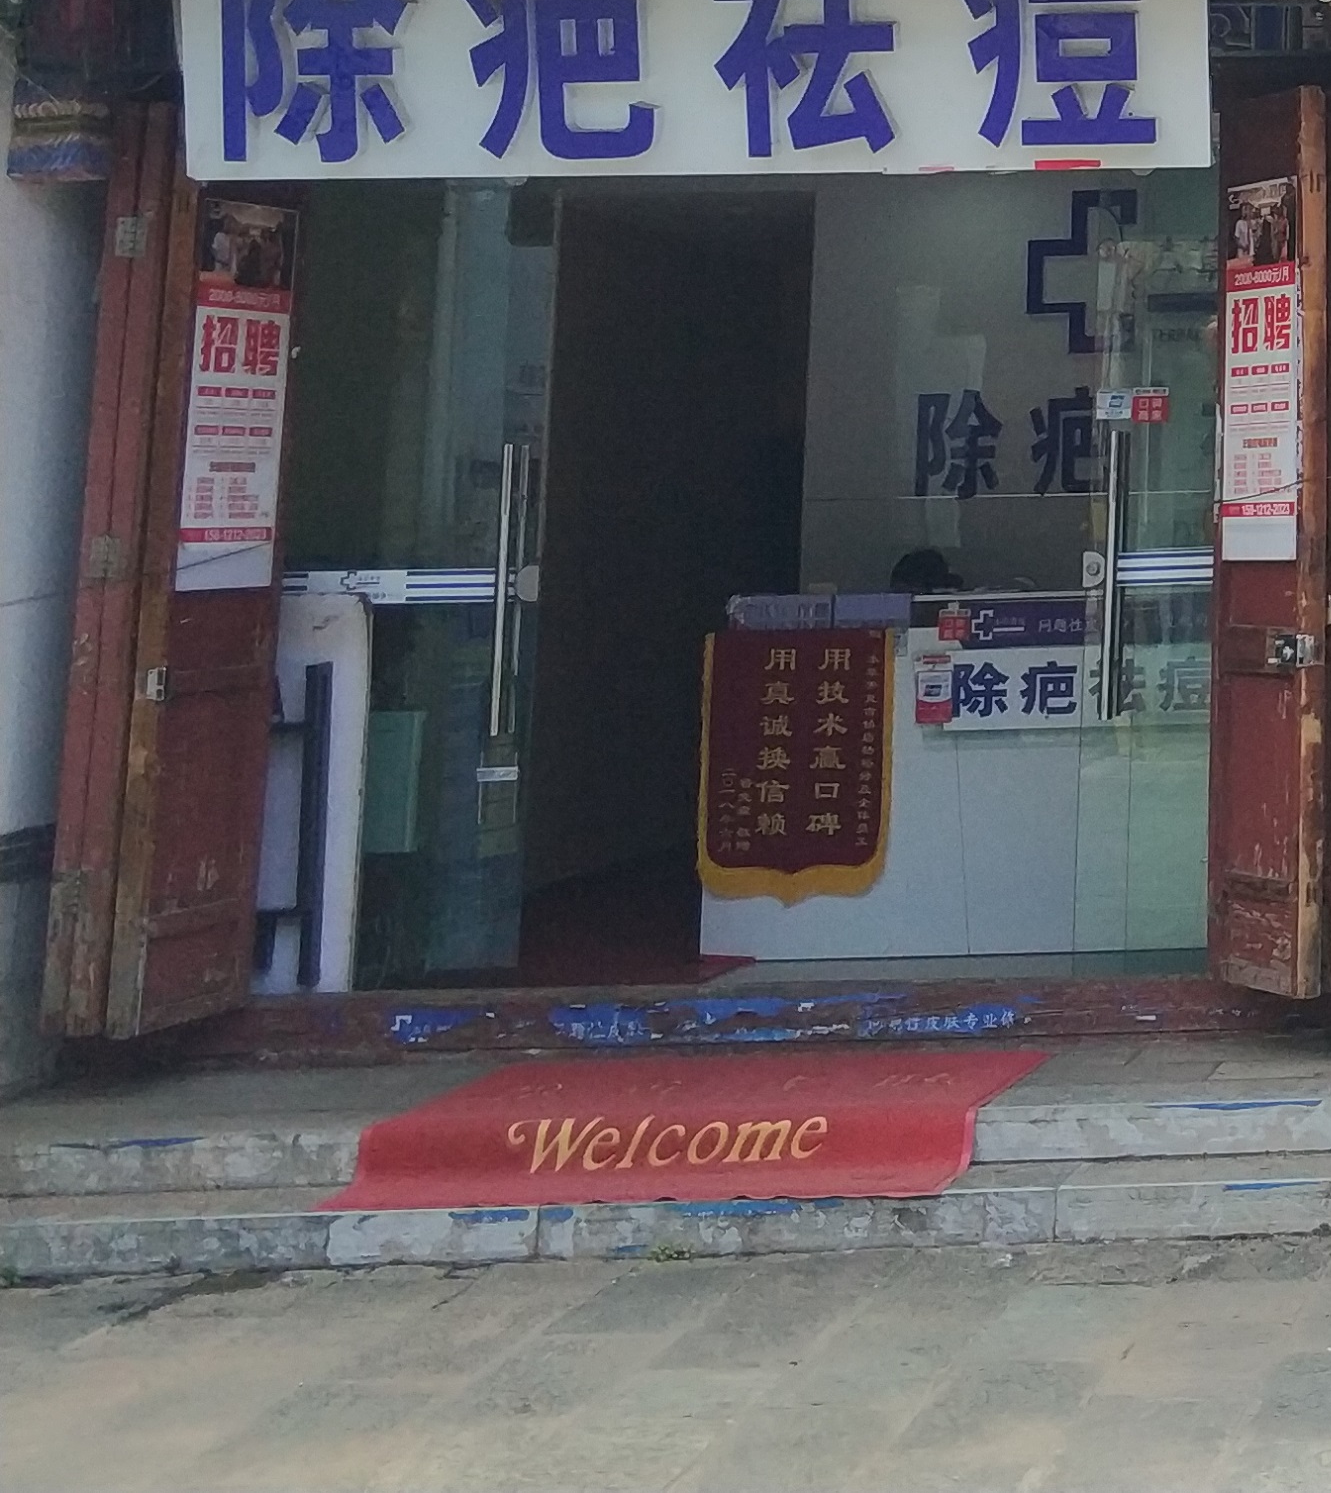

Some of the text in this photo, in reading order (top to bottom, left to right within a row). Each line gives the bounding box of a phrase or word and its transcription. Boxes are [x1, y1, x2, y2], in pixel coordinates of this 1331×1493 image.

[200, 314, 282, 376] 招聘
[1231, 292, 1291, 354] 招聘
[755, 648, 797, 837] 用真诚换信赖
[806, 647, 852, 837] 用技术赢口碑
[507, 1114, 830, 1175] Welcome
